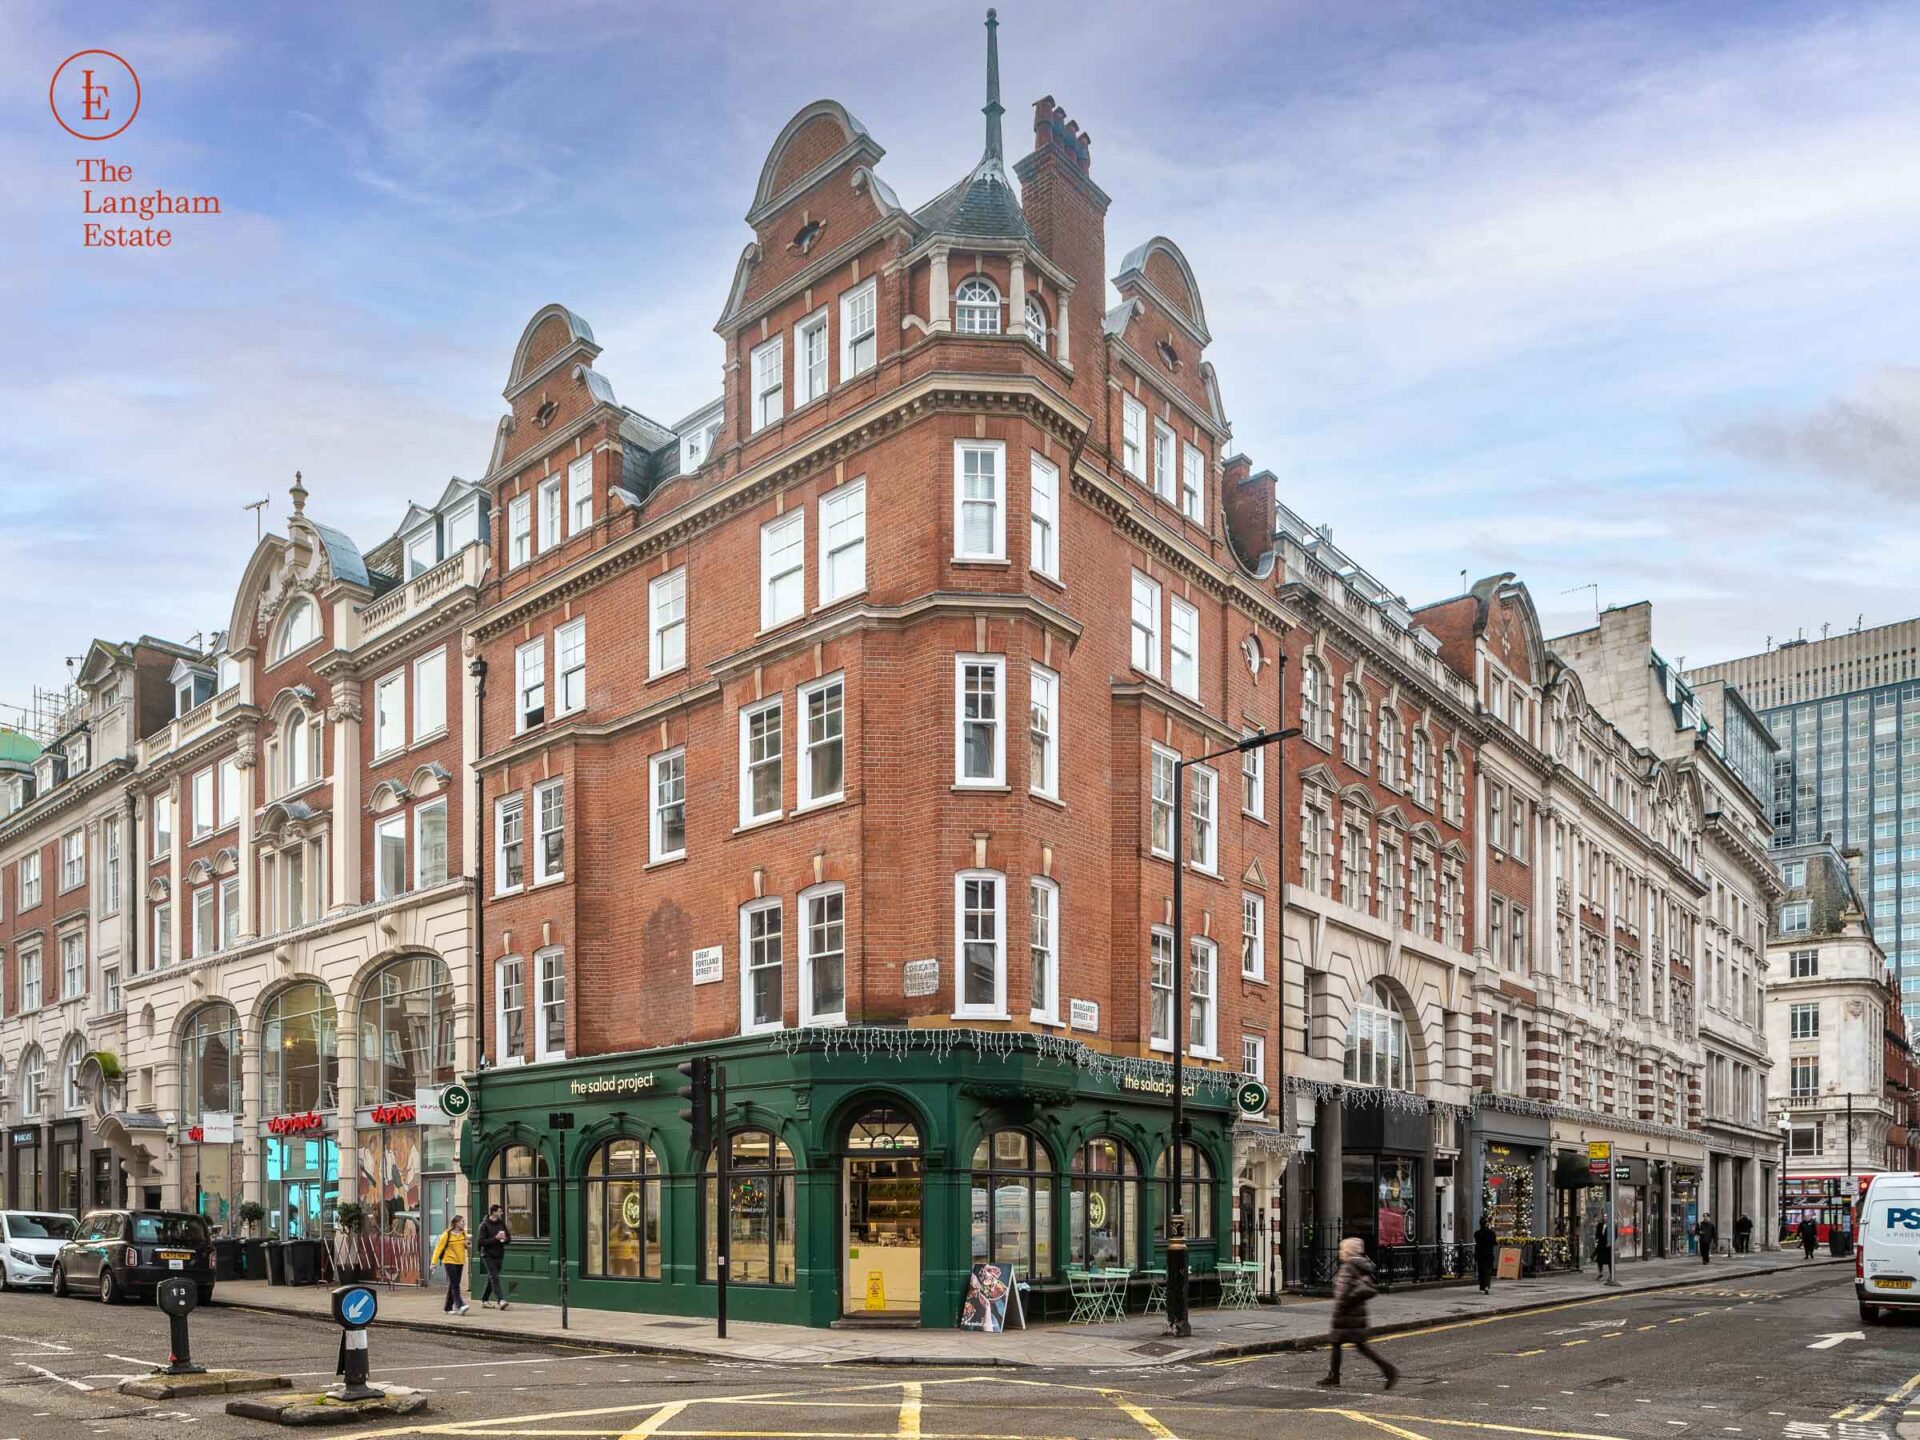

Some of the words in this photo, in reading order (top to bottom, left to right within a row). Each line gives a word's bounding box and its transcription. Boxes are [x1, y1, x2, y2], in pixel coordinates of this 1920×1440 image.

[696, 950, 710, 960] GREAT
[696, 957, 720, 968] PORTLAND
[696, 966, 711, 977] STREET
[1073, 1002, 1096, 1014] MARGARET
[1073, 1011, 1088, 1021] STREET
[571, 1079, 587, 1095] the
[588, 1075, 615, 1094] salad
[618, 1072, 654, 1094] project
[1125, 1073, 1139, 1089] the
[1140, 1077, 1164, 1093] salad
[1165, 1083, 1195, 1098] prect
[268, 1110, 323, 1135] VAPIANO
